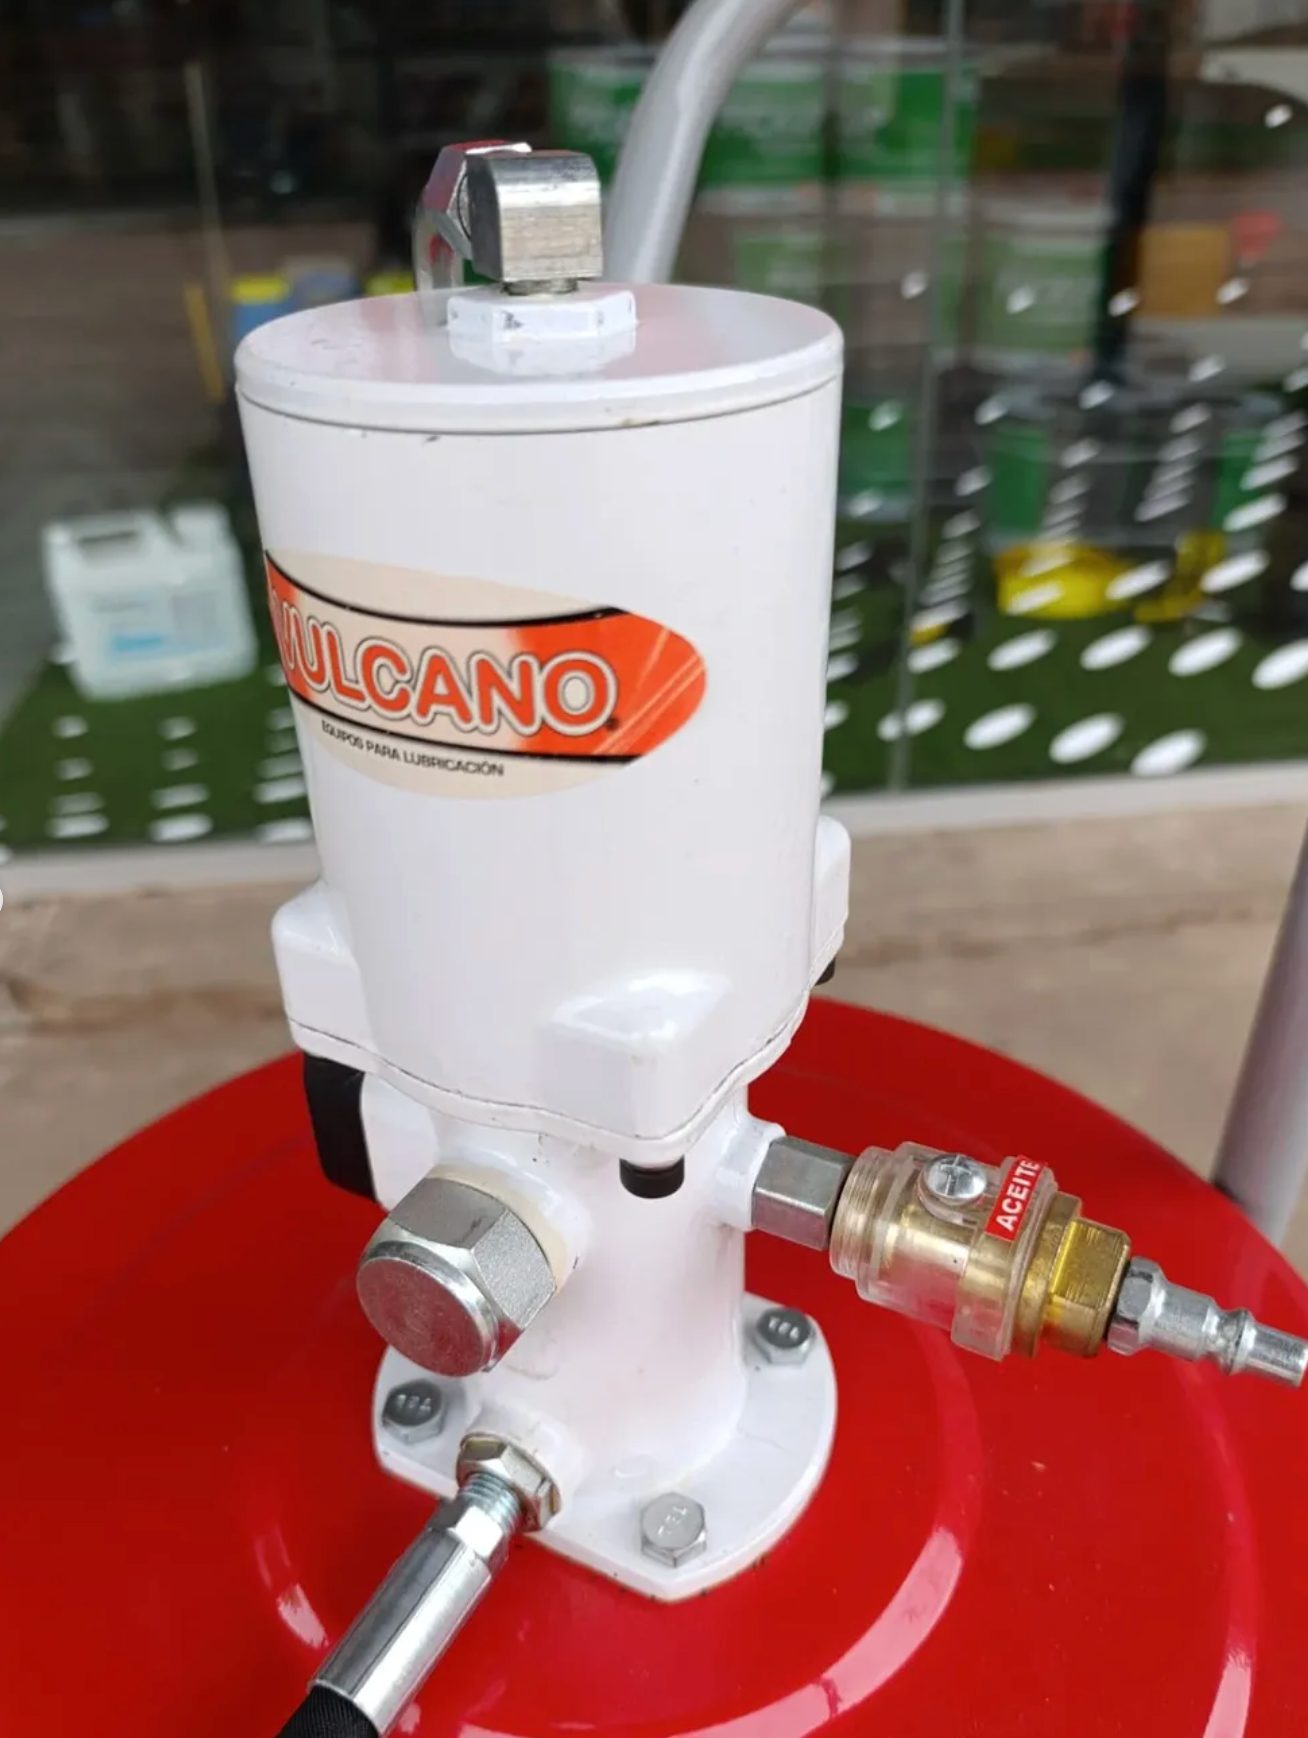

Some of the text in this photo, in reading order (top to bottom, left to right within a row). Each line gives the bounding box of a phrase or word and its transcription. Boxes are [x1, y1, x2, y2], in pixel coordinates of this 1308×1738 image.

[321, 719, 504, 776] EQUIPOS PARA LUBRICACIÓN
[995, 1160, 1041, 1231] ACEITE
